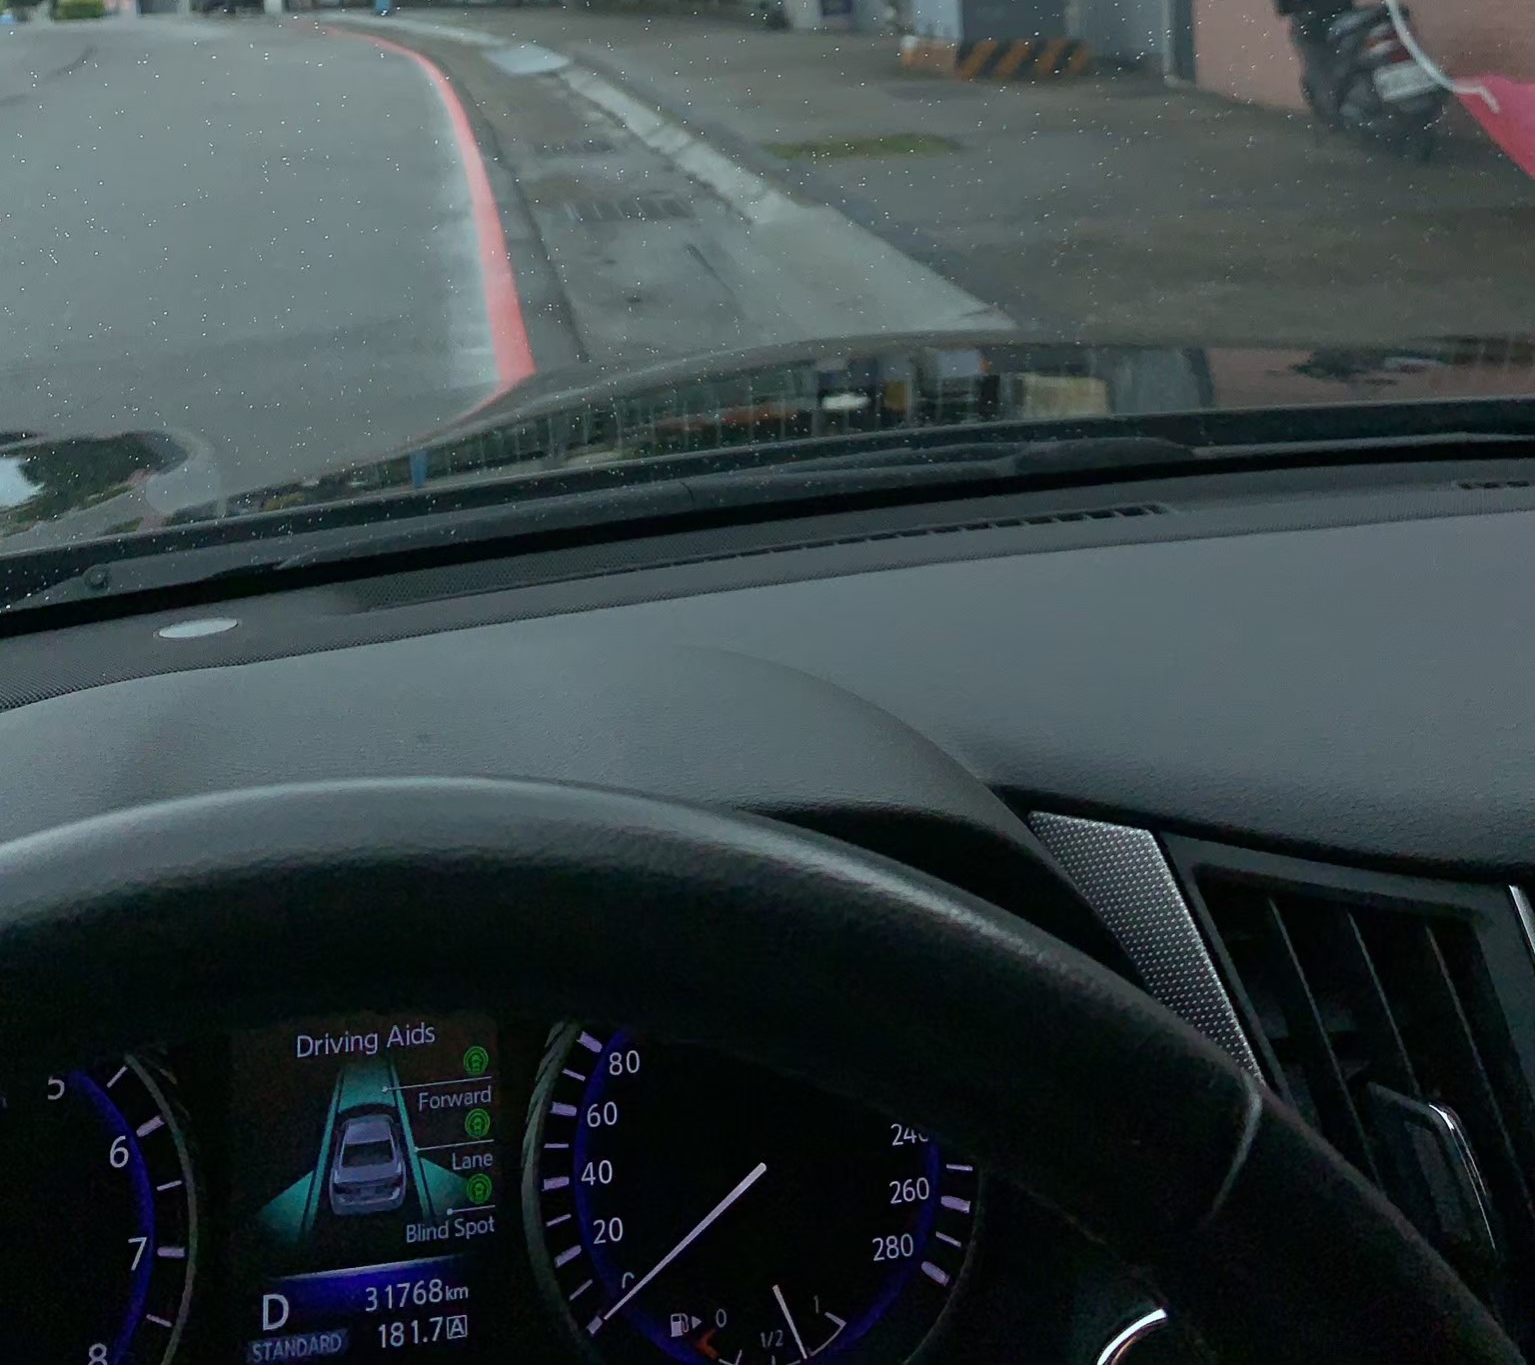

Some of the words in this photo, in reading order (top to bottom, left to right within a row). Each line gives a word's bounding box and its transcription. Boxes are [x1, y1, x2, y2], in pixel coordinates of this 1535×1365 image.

[296, 1030, 379, 1059] Driving
[386, 1022, 436, 1048] Aids
[609, 1050, 640, 1076] 80
[47, 1075, 65, 1100] 5
[418, 1085, 493, 1112] Forward
[587, 1101, 618, 1128] 60
[109, 1135, 130, 1168] 6
[451, 1152, 493, 1171] Lane
[581, 1159, 613, 1186] 40
[889, 1177, 930, 1204] 260
[406, 1220, 450, 1244] Blind
[454, 1215, 495, 1240] Spot
[593, 1217, 623, 1244] 20
[127, 1236, 147, 1271] 7
[872, 1233, 914, 1261] 280
[262, 1293, 290, 1332] D
[715, 1308, 728, 1328] 0
[252, 1333, 343, 1364] STANDARD
[760, 1329, 785, 1348] 1/2
